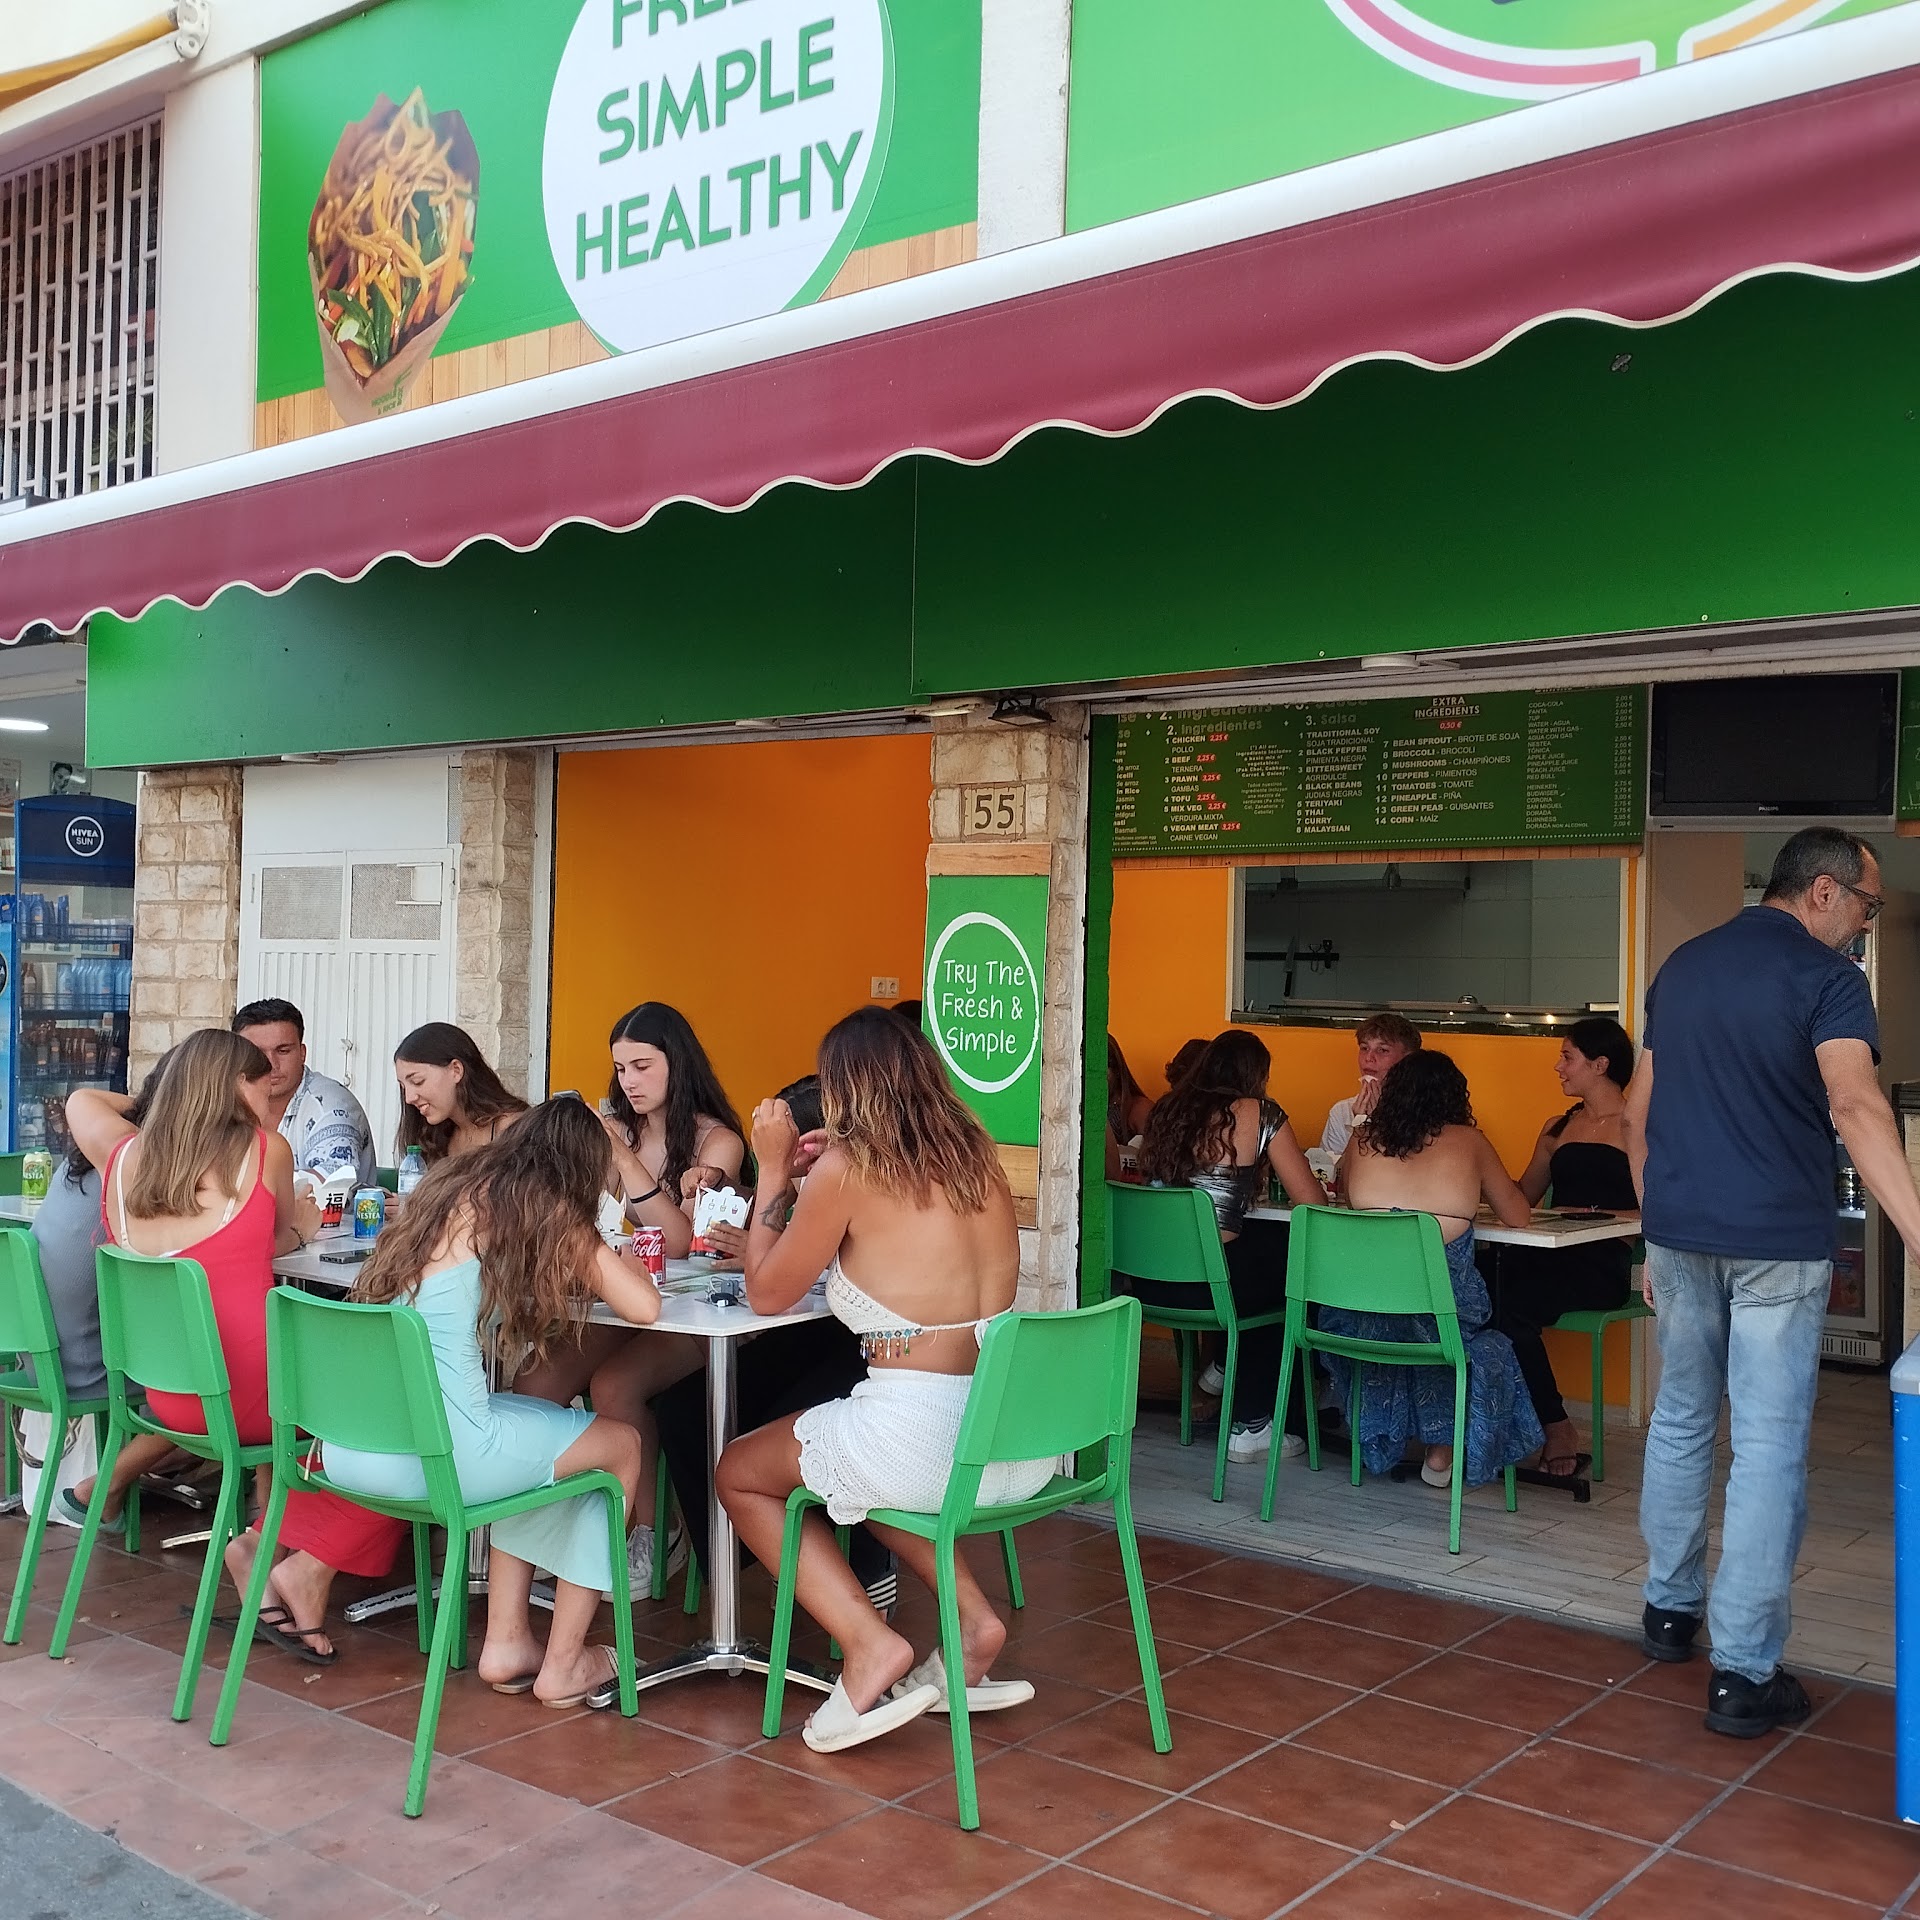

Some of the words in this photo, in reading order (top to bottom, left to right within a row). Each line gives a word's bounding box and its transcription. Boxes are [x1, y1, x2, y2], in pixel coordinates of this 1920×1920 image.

[597, 17, 834, 164] SIMPLE
[576, 129, 863, 281] HEALTHY
[1432, 696, 1465, 706] EXTRA
[1415, 705, 1480, 718] INGREDIENTS
[1306, 715, 1316, 726] 3.
[1321, 713, 1356, 724] Salsa
[1167, 725, 1177, 736] 2.
[1307, 729, 1361, 738] TRADITIONAL
[1172, 735, 1206, 744] CHICKEN
[1327, 737, 1375, 745] TRADICIONAL
[1393, 739, 1416, 747] BEAN
[1418, 736, 1452, 745] SPROUT
[1458, 734, 1485, 743] BROTE
[1486, 733, 1497, 741] DE
[1499, 732, 1520, 740] SOJA
[1307, 747, 1333, 756] BLACK
[1336, 746, 1367, 754] PEPPER
[1393, 749, 1435, 758] BROCCOLI
[1441, 746, 1476, 755] BROCOLI
[1341, 754, 1366, 762] NEGRA
[1392, 760, 1447, 769] MUSHROOMS
[1453, 756, 1511, 766] CHAMPIÑONES
[1172, 765, 1203, 773] TERNERA
[1306, 764, 1363, 773] BITTERSWEET
[1306, 773, 1347, 781] AGRIDULCE
[1392, 771, 1429, 780] PEPPERS
[1435, 769, 1477, 777] PIMIENTOS
[1306, 782, 1332, 790] BLACK
[1335, 781, 1362, 789] BEANS
[1391, 782, 1436, 791] TOMATOES
[1443, 780, 1474, 789] TOMATE
[1391, 793, 1437, 802] PINEAPPLE
[1443, 791, 1462, 799] PIÑA
[974, 794, 1015, 830] 55
[1390, 805, 1419, 813] GREEN
[1421, 804, 1444, 812] PEAS
[1449, 802, 1494, 810] GUISANTES
[1171, 814, 1202, 822] VERDURA
[1375, 817, 1386, 825] 14
[1390, 816, 1414, 824] CORN
[1420, 814, 1439, 822] MAÍZ
[71, 829, 98, 837] NIVEA
[1170, 824, 1196, 832] VEGAN
[1304, 825, 1350, 833] MALAYSIAN
[76, 837, 94, 845] SUN
[985, 960, 1026, 986] The
[1011, 998, 1024, 1020] &
[945, 1026, 1018, 1060] Simple
[325, 1192, 344, 1215] 福
[356, 1212, 381, 1220] NESTEA
[632, 1234, 662, 1256] Cola
